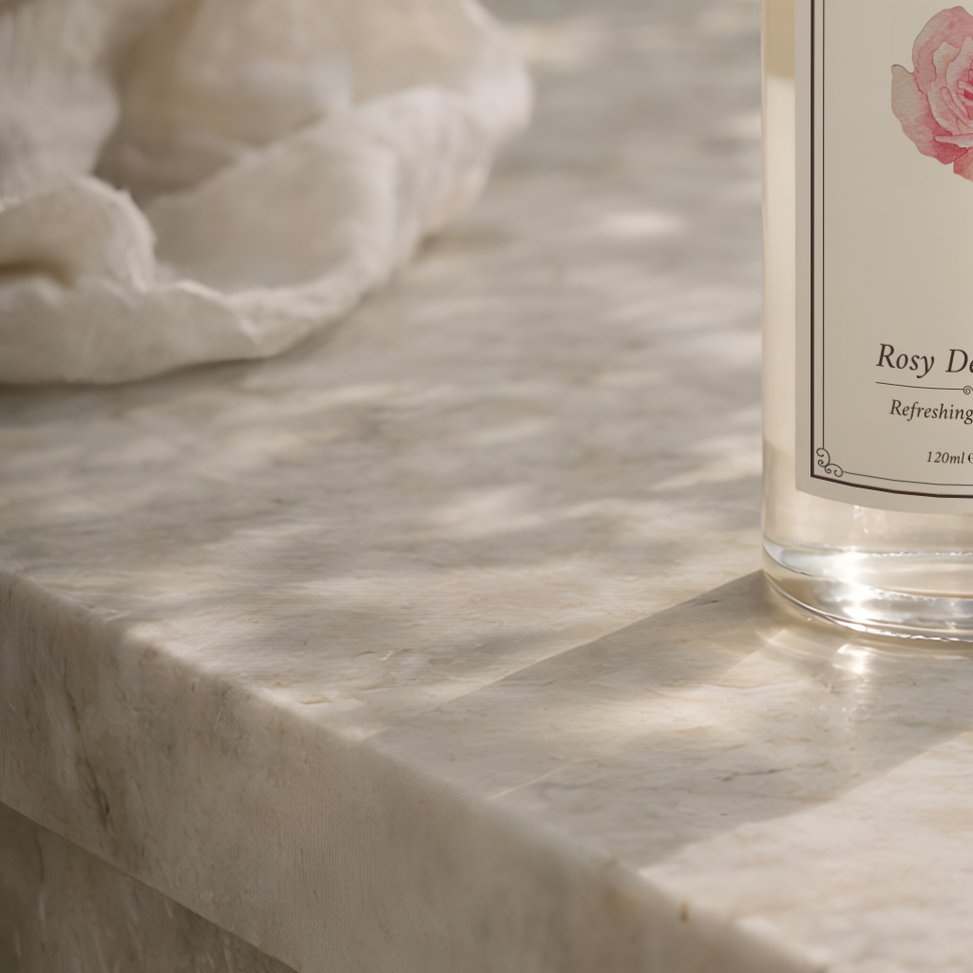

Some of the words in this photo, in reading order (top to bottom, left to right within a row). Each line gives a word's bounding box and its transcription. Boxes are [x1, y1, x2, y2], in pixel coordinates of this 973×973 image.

[876, 343, 935, 379] Rosy
[889, 399, 973, 425] Refreshing
[926, 451, 965, 464] 120ml
